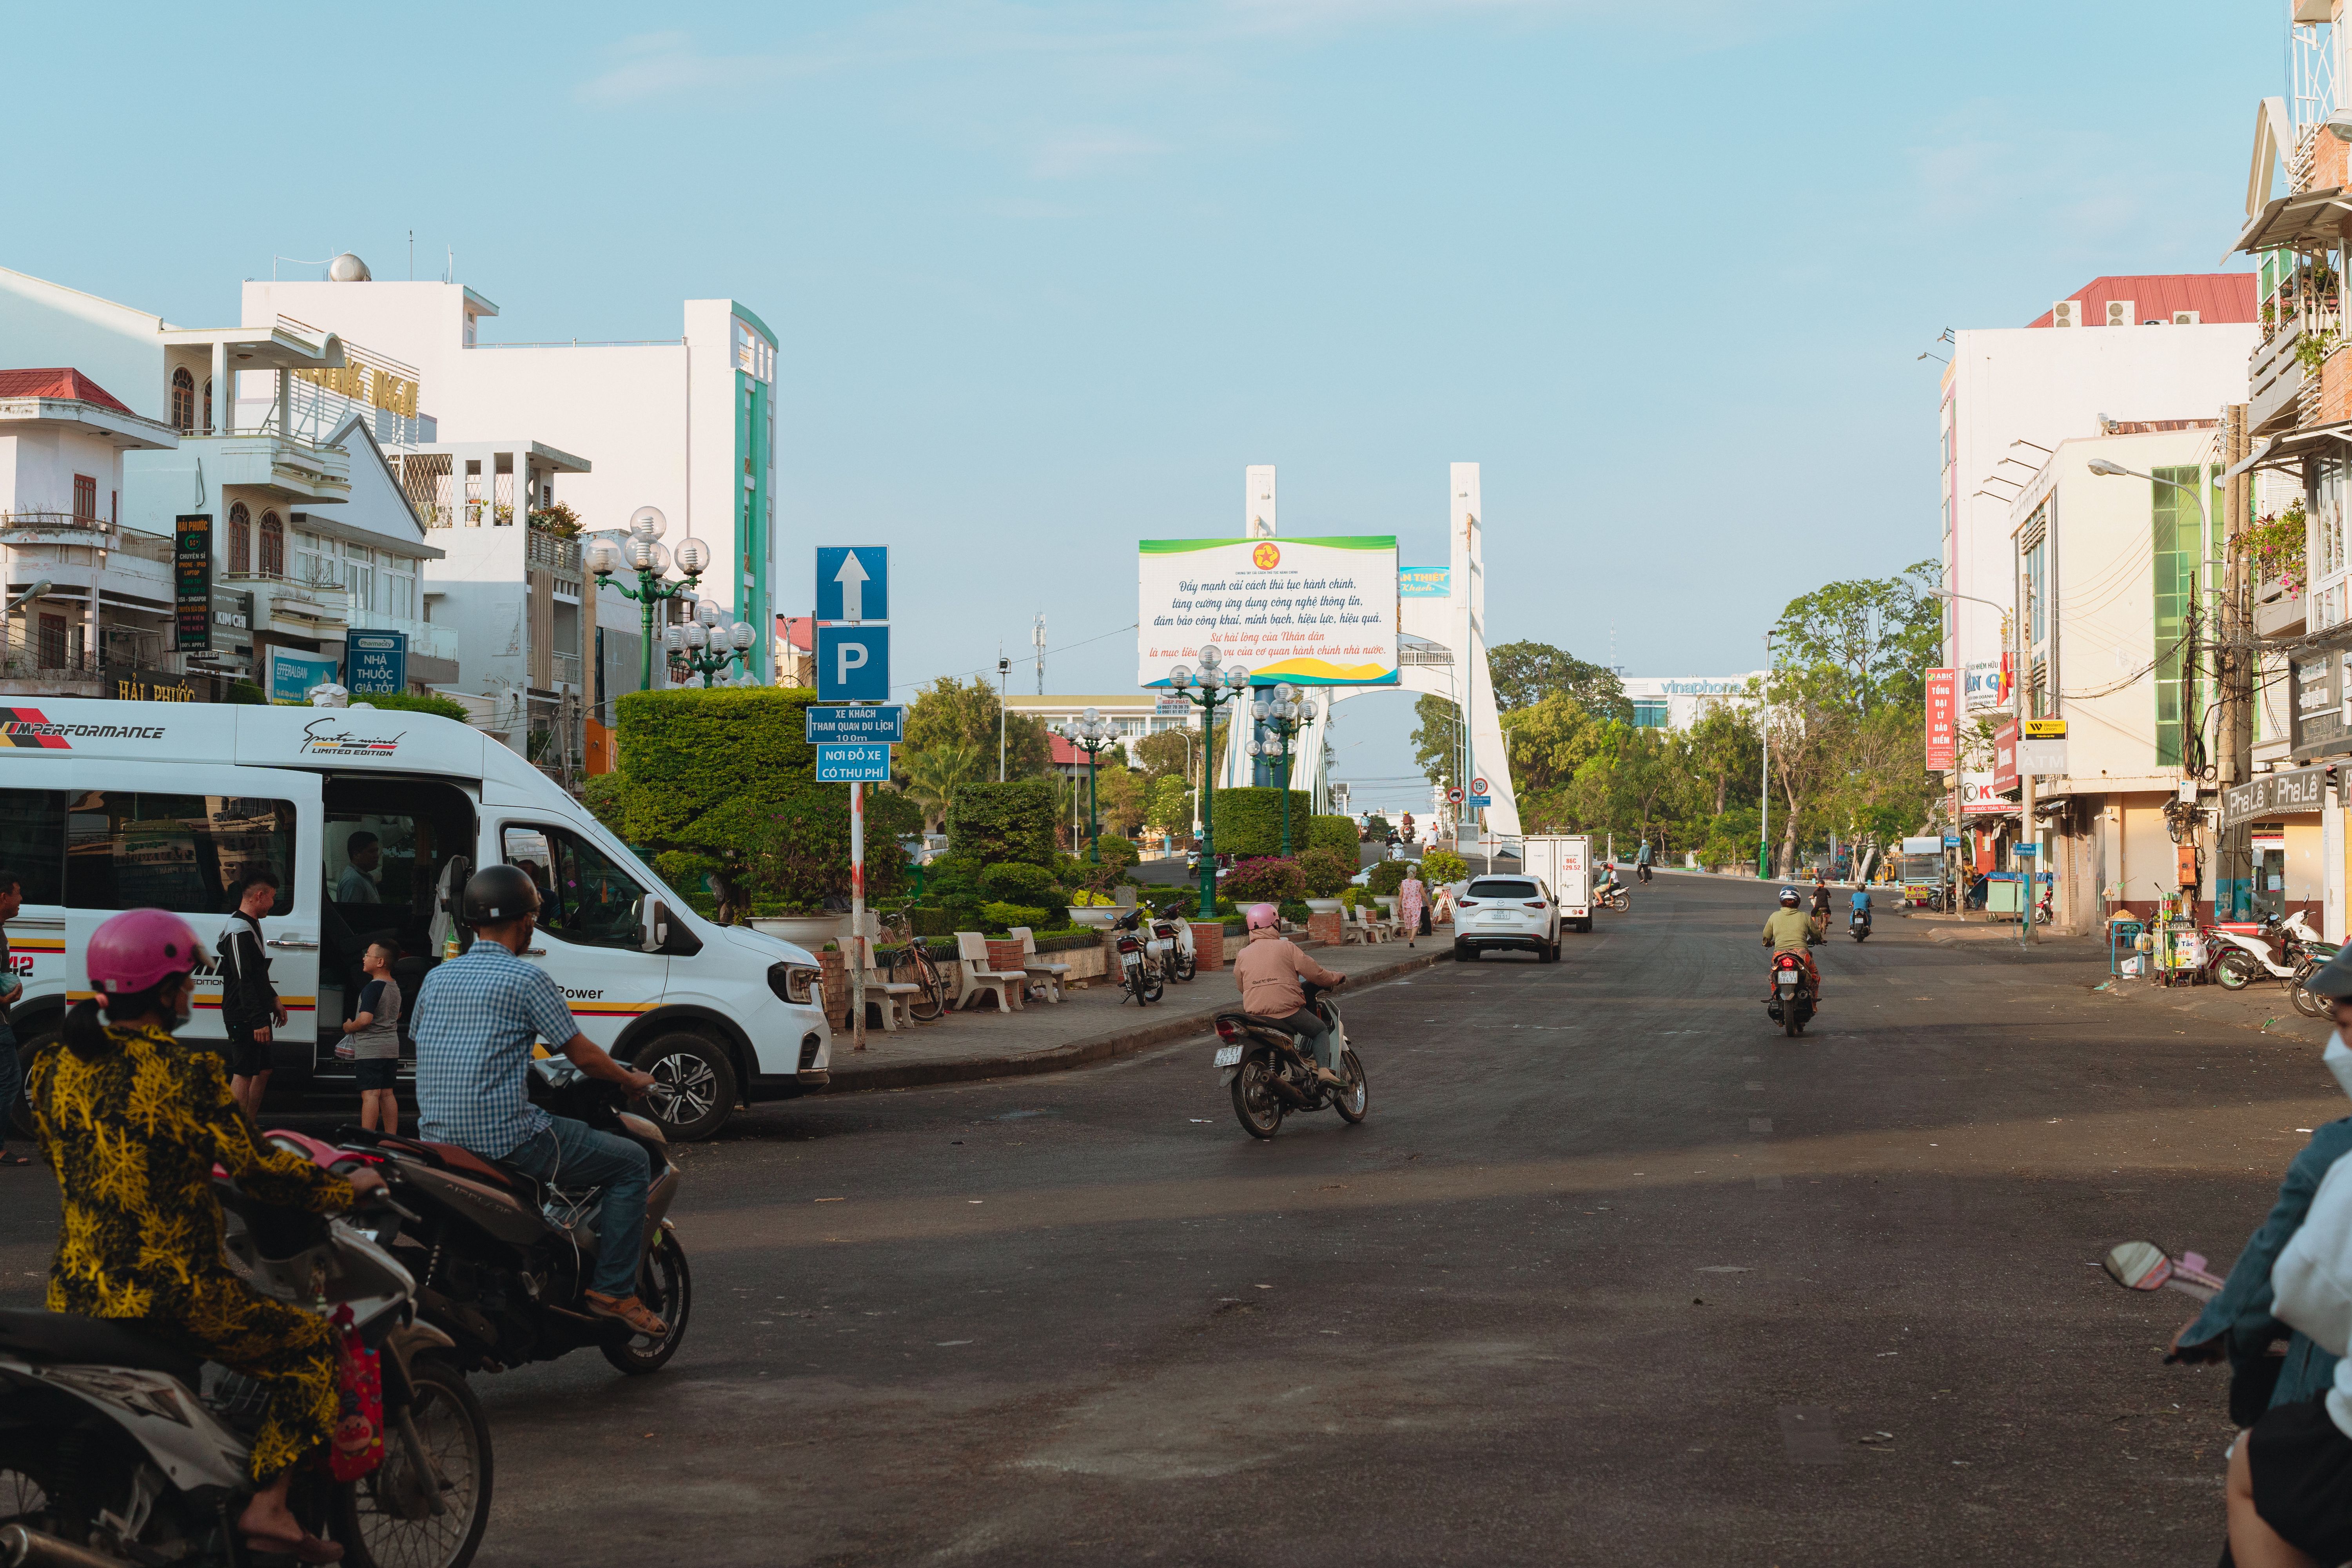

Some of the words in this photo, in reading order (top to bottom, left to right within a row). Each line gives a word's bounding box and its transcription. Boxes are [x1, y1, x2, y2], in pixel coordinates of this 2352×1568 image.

[178, 518, 187, 532] HẢI
[189, 519, 207, 531] PHƯỚC
[1414, 572, 1446, 581] THIẾT
[1180, 579, 1198, 595] Đẩy
[1201, 580, 1227, 593] mạnh
[1229, 580, 1243, 590] cải
[1246, 579, 1267, 590] cách
[1270, 579, 1284, 590] thủ
[1287, 579, 1301, 591] tục
[1303, 578, 1326, 589] hành
[1329, 578, 1356, 589] chính,
[1172, 598, 1192, 612] tăng
[1196, 598, 1222, 612] cường
[1225, 598, 1242, 611] ứng
[1245, 597, 1268, 611] dụng
[1271, 597, 1292, 610] công
[1295, 596, 1318, 610] nghệ
[1320, 595, 1345, 610] thông
[1348, 595, 1363, 606] tin,
[217, 611, 231, 626] KIM
[232, 614, 246, 628] CHI
[1154, 615, 1174, 626] đảm
[1177, 615, 1194, 626] bảo
[1196, 616, 1217, 629] công
[1220, 614, 1241, 625] khai,
[1245, 614, 1267, 624] minh
[1270, 613, 1294, 626] bạch,
[1298, 613, 1317, 626] hiệu
[1320, 613, 1336, 625] lực,
[1339, 613, 1359, 625] hiệu
[1362, 612, 1381, 626] quả.
[1210, 632, 1221, 644] Sự
[1224, 632, 1239, 642] hài
[1241, 632, 1259, 645] lòng
[1263, 632, 1278, 641] của
[1281, 631, 1305, 641] Nhân
[1308, 631, 1325, 641] dân
[1150, 648, 1158, 657] là
[1161, 649, 1179, 659] mục
[1182, 647, 1198, 657] tiêu
[1224, 650, 1235, 658] vụ
[1237, 646, 1254, 656] của
[1256, 647, 1267, 655] cơ
[1268, 648, 1290, 658] quan
[1293, 645, 1314, 655] hành
[1318, 644, 1341, 655] chính
[1344, 644, 1360, 655] nhà
[1363, 644, 1386, 654] nước.
[364, 653, 387, 665] NHÀ
[838, 643, 868, 684] P
[277, 663, 307, 679] EFFERALGAN
[357, 666, 393, 679] THUỐC
[1976, 662, 1986, 671] NHIỆM
[118, 672, 145, 701] HẢI
[154, 679, 195, 702] PHƯỚC
[355, 681, 372, 693] GIÁ
[376, 680, 395, 693] TỐT
[1661, 680, 1741, 695] vinaphone
[1932, 685, 1949, 695] TỔNG
[1935, 699, 1947, 708] ĐẠI
[836, 710, 846, 718] XE
[849, 708, 876, 718] KHÁCH
[1937, 710, 1944, 719] LÝ
[838, 722, 859, 732] QUAN
[862, 722, 873, 730] DU
[876, 720, 893, 732] LỊCH
[1935, 722, 1947, 731] BẢO
[1933, 734, 1950, 744] HIỂM
[826, 750, 845, 760] NƠI
[848, 748, 864, 760] ĐỖ
[867, 751, 880, 760] XE
[2022, 756, 2063, 768] ATM
[822, 767, 837, 778] CÓ
[840, 769, 862, 777] THU
[865, 766, 884, 777] PHÍ
[2278, 777, 2300, 803] Pha
[2302, 774, 2317, 801] Lê
[2230, 791, 2249, 816] Pha
[2250, 783, 2264, 810] Lê
[557, 986, 604, 999] Power
[1220, 1047, 1238, 1057] 70-E1
[1216, 1055, 1238, 1065] 262.21
